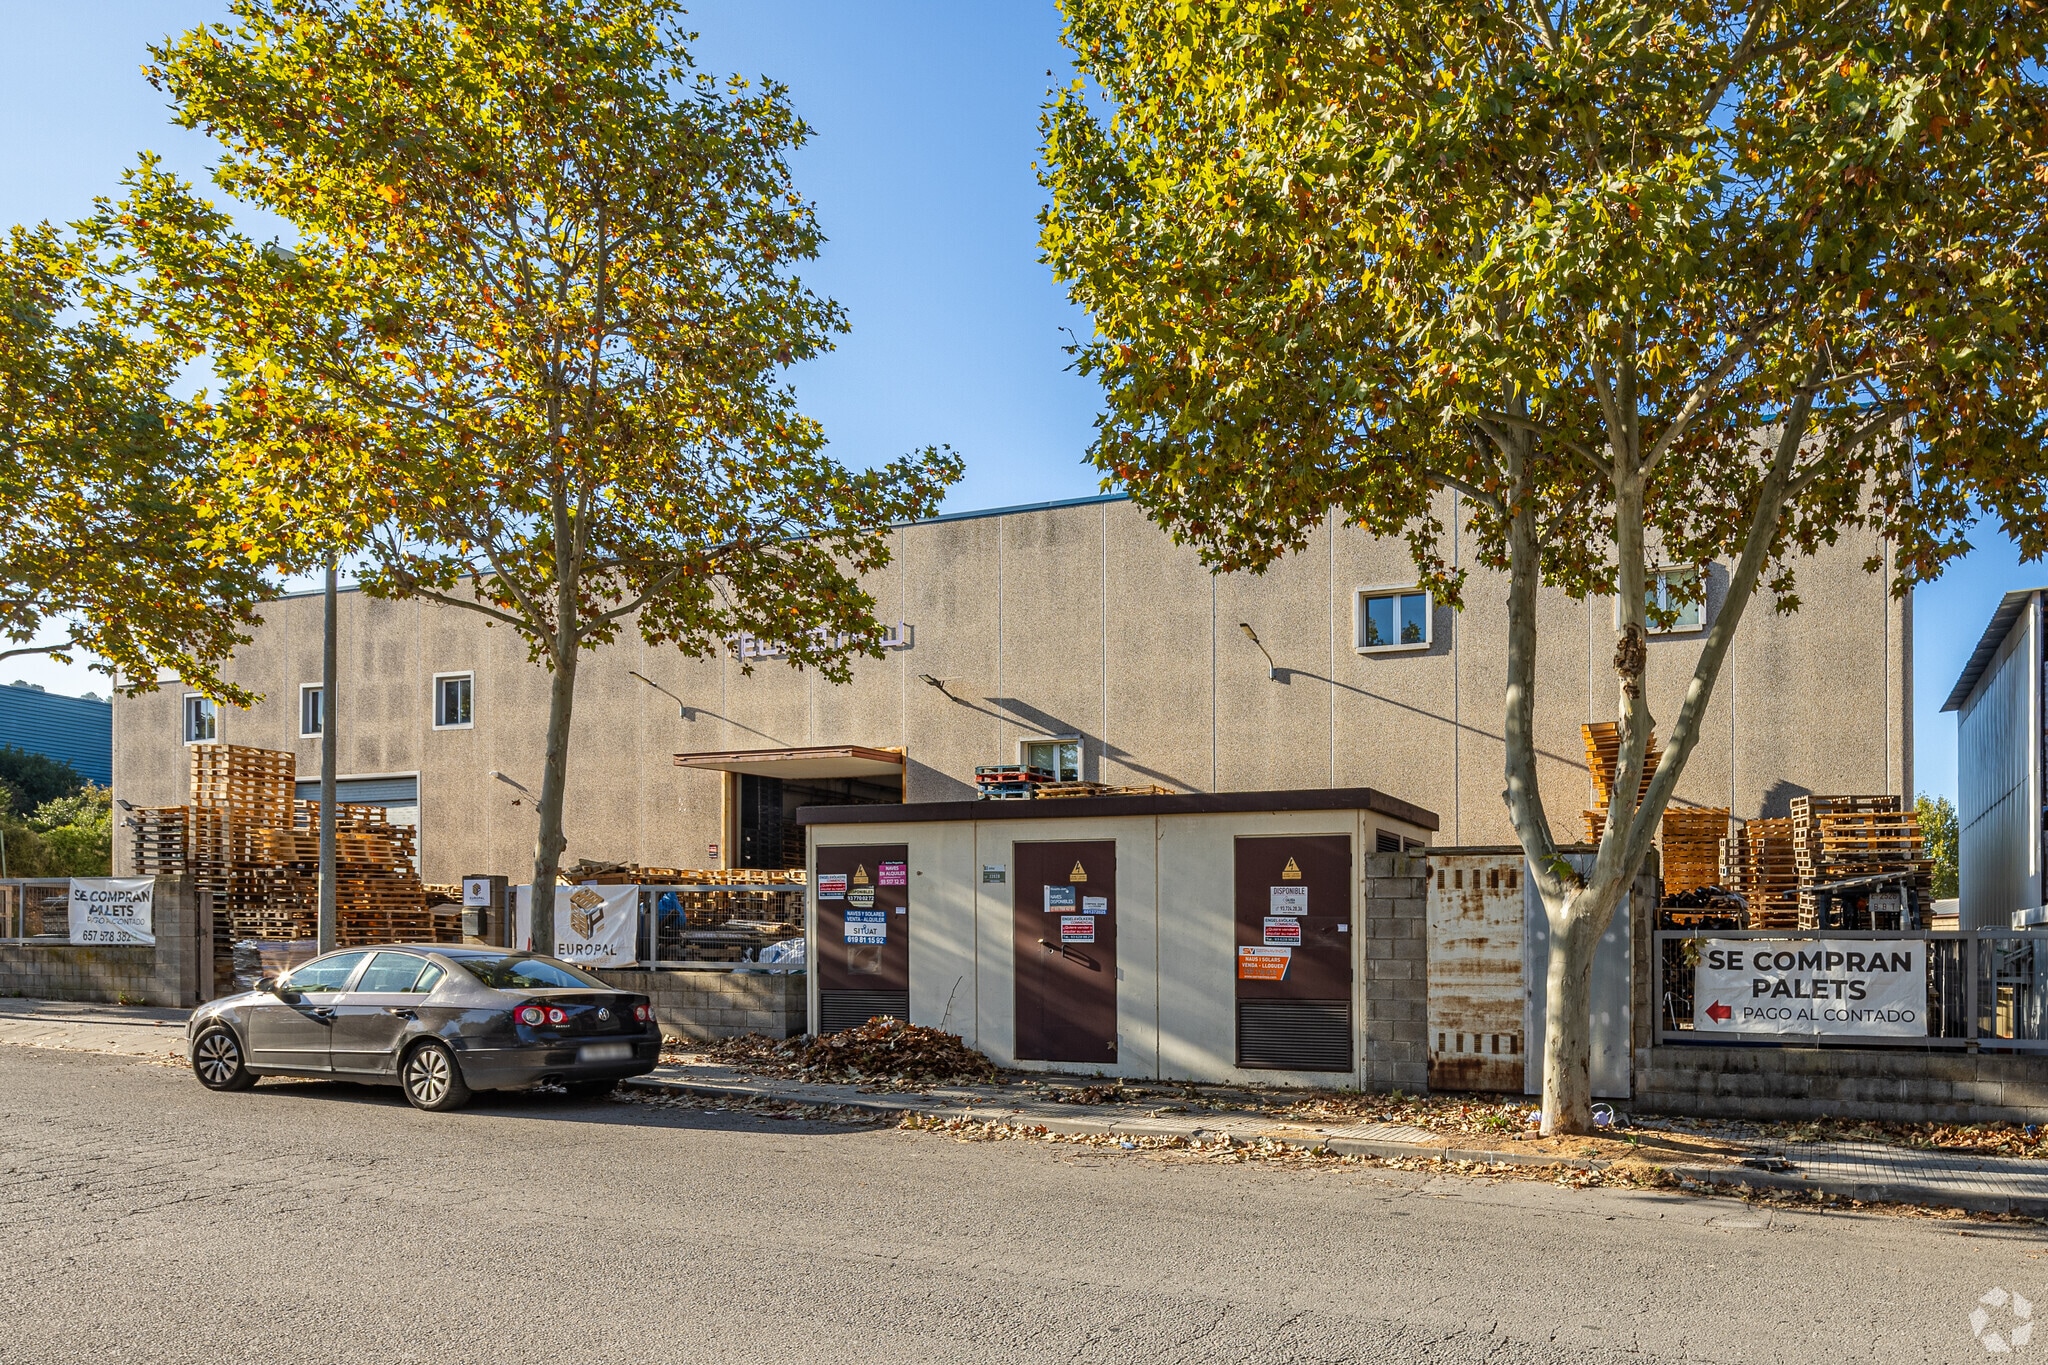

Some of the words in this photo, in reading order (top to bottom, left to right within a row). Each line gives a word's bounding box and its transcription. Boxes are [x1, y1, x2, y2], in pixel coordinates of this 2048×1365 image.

[74, 889, 88, 901] SE
[90, 890, 150, 902] COMPRAN
[89, 904, 134, 916] PALETS
[83, 930, 97, 941] 657
[100, 931, 114, 942] 578
[558, 943, 617, 956] EUROPAL
[1708, 950, 1744, 970] SE
[1752, 951, 1912, 972] COMPRAN
[1752, 978, 1867, 1000] PALETS
[1743, 1007, 1792, 1020] PAGO
[1797, 1008, 1819, 1021] AL
[1824, 1008, 1916, 1023] CONTADO
